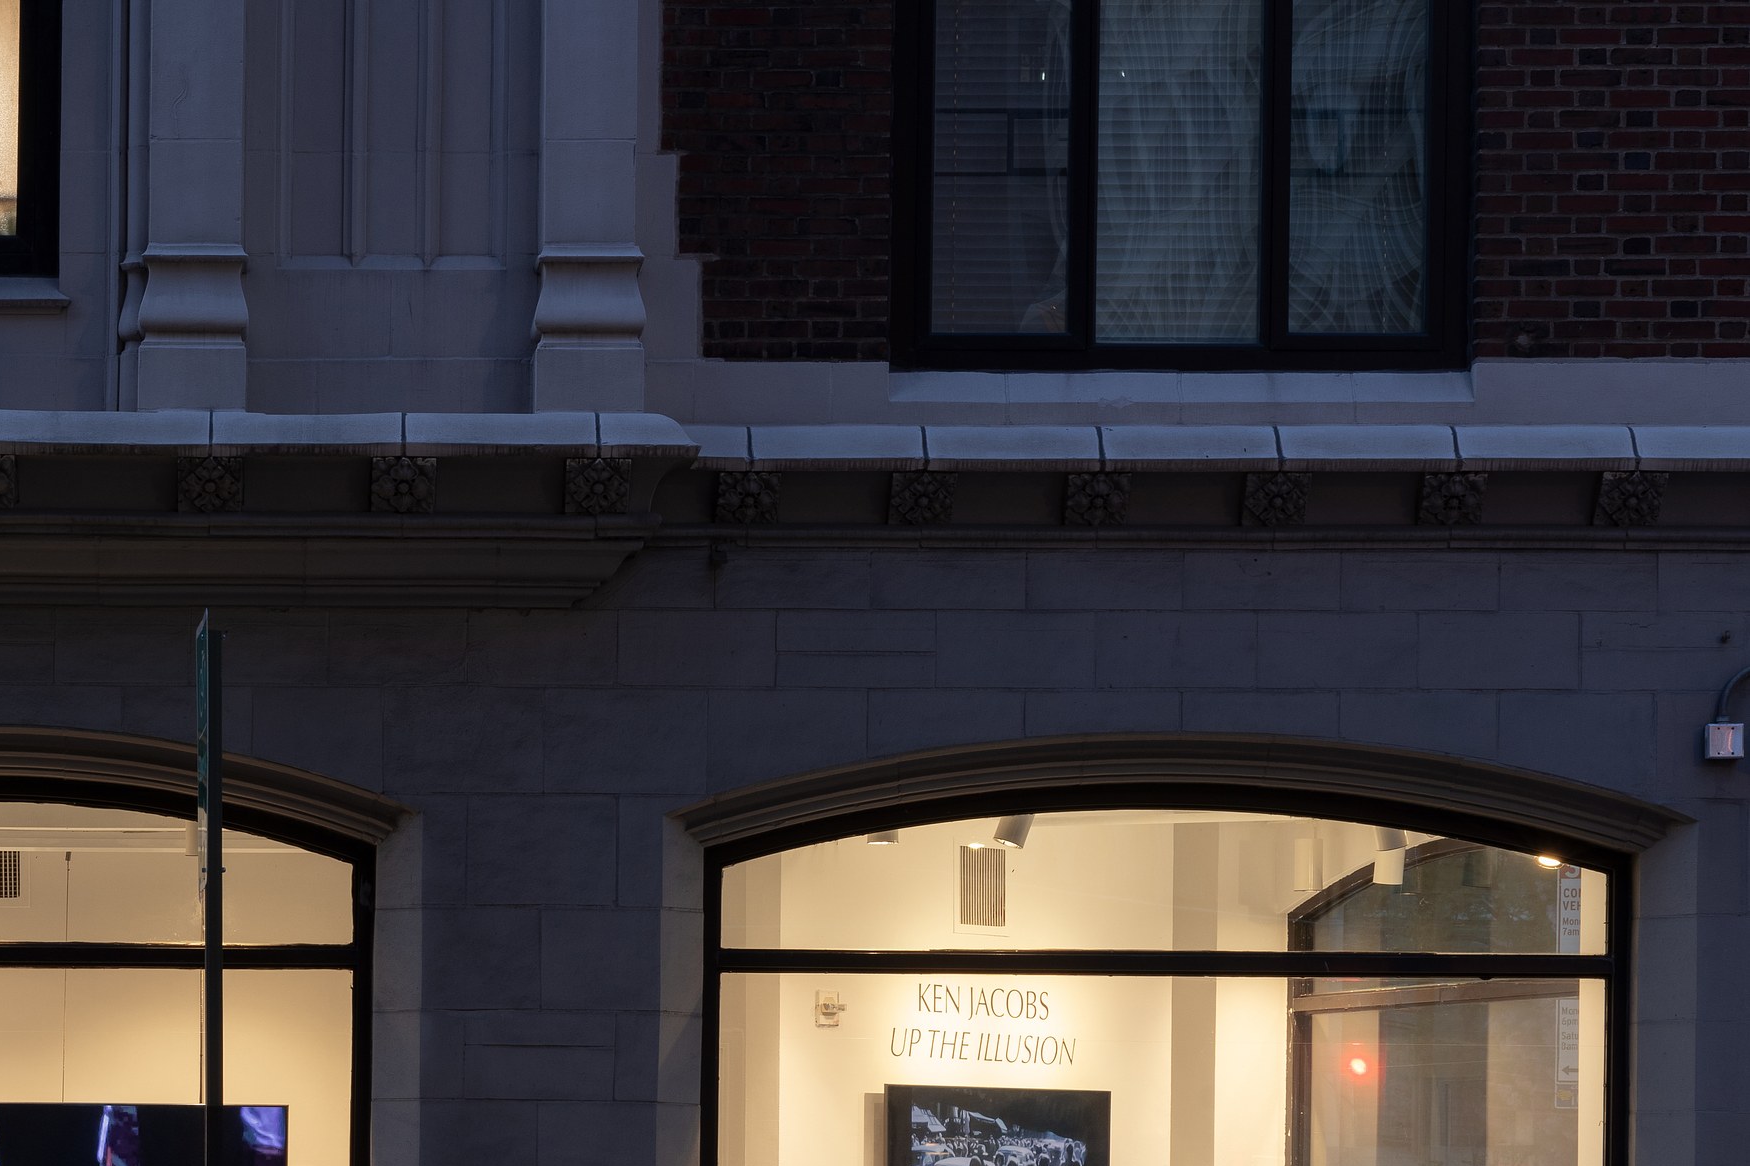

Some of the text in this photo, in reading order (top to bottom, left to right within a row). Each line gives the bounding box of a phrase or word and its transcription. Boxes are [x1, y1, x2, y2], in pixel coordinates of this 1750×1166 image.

[1564, 888, 1581, 898] CO
[918, 983, 1049, 1020] KEN JACOBS
[890, 1027, 1076, 1066] UP THE ILLUSION
